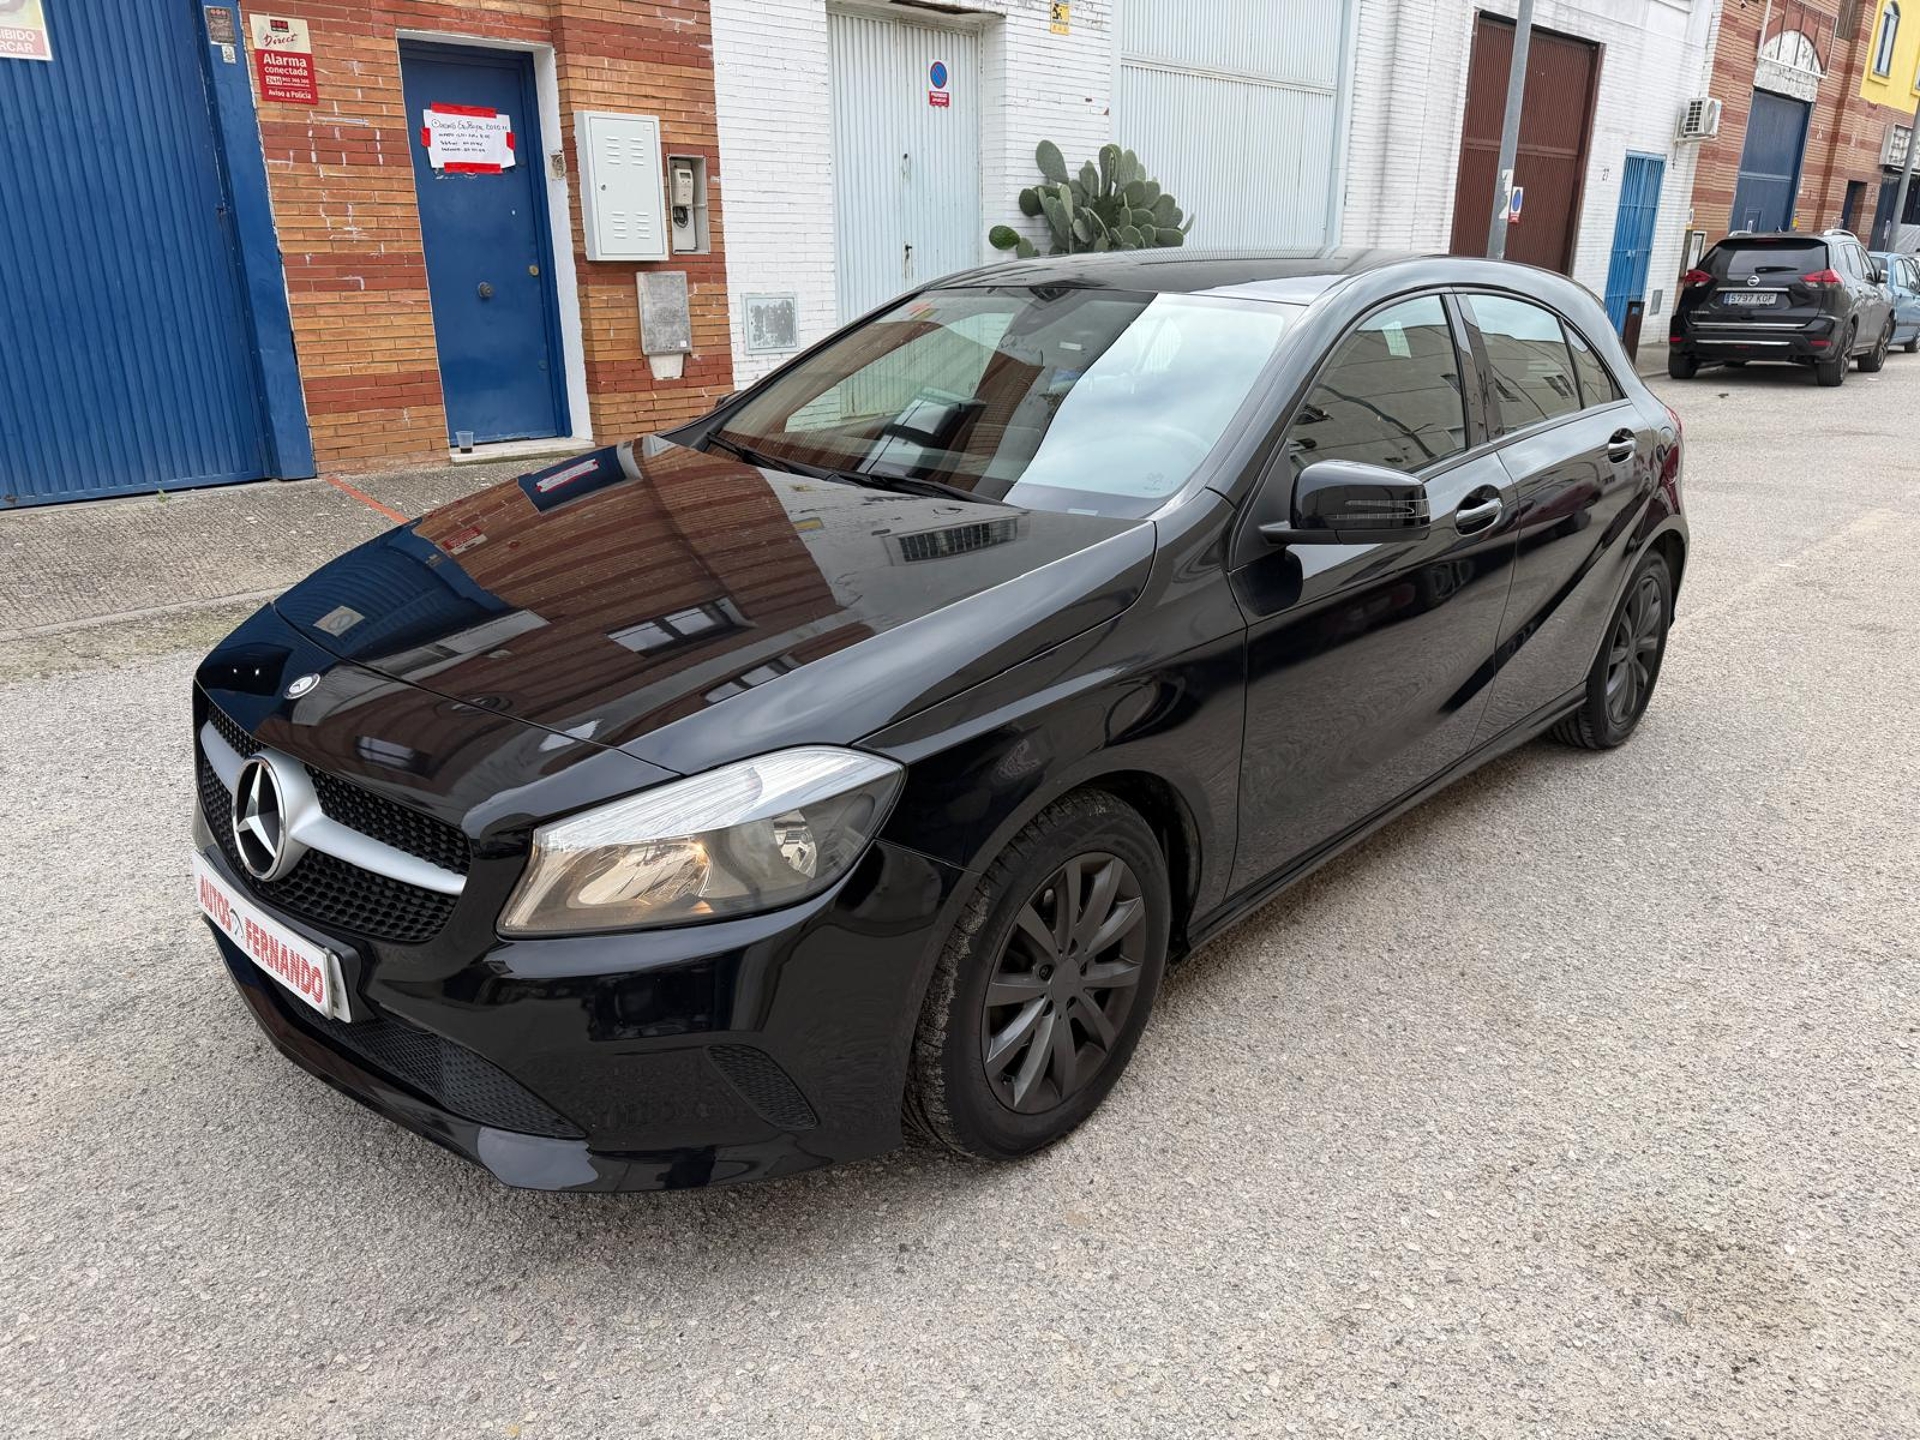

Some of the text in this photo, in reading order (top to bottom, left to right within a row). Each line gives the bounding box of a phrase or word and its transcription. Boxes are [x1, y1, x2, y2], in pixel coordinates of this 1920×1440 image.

[0, 28, 36, 42] IBIDO
[263, 52, 307, 68] Alarma
[264, 66, 308, 76] conectada
[268, 89, 285, 97] Aviso
[200, 875, 232, 932] AUTOS
[245, 916, 324, 1004] FERNANDO
